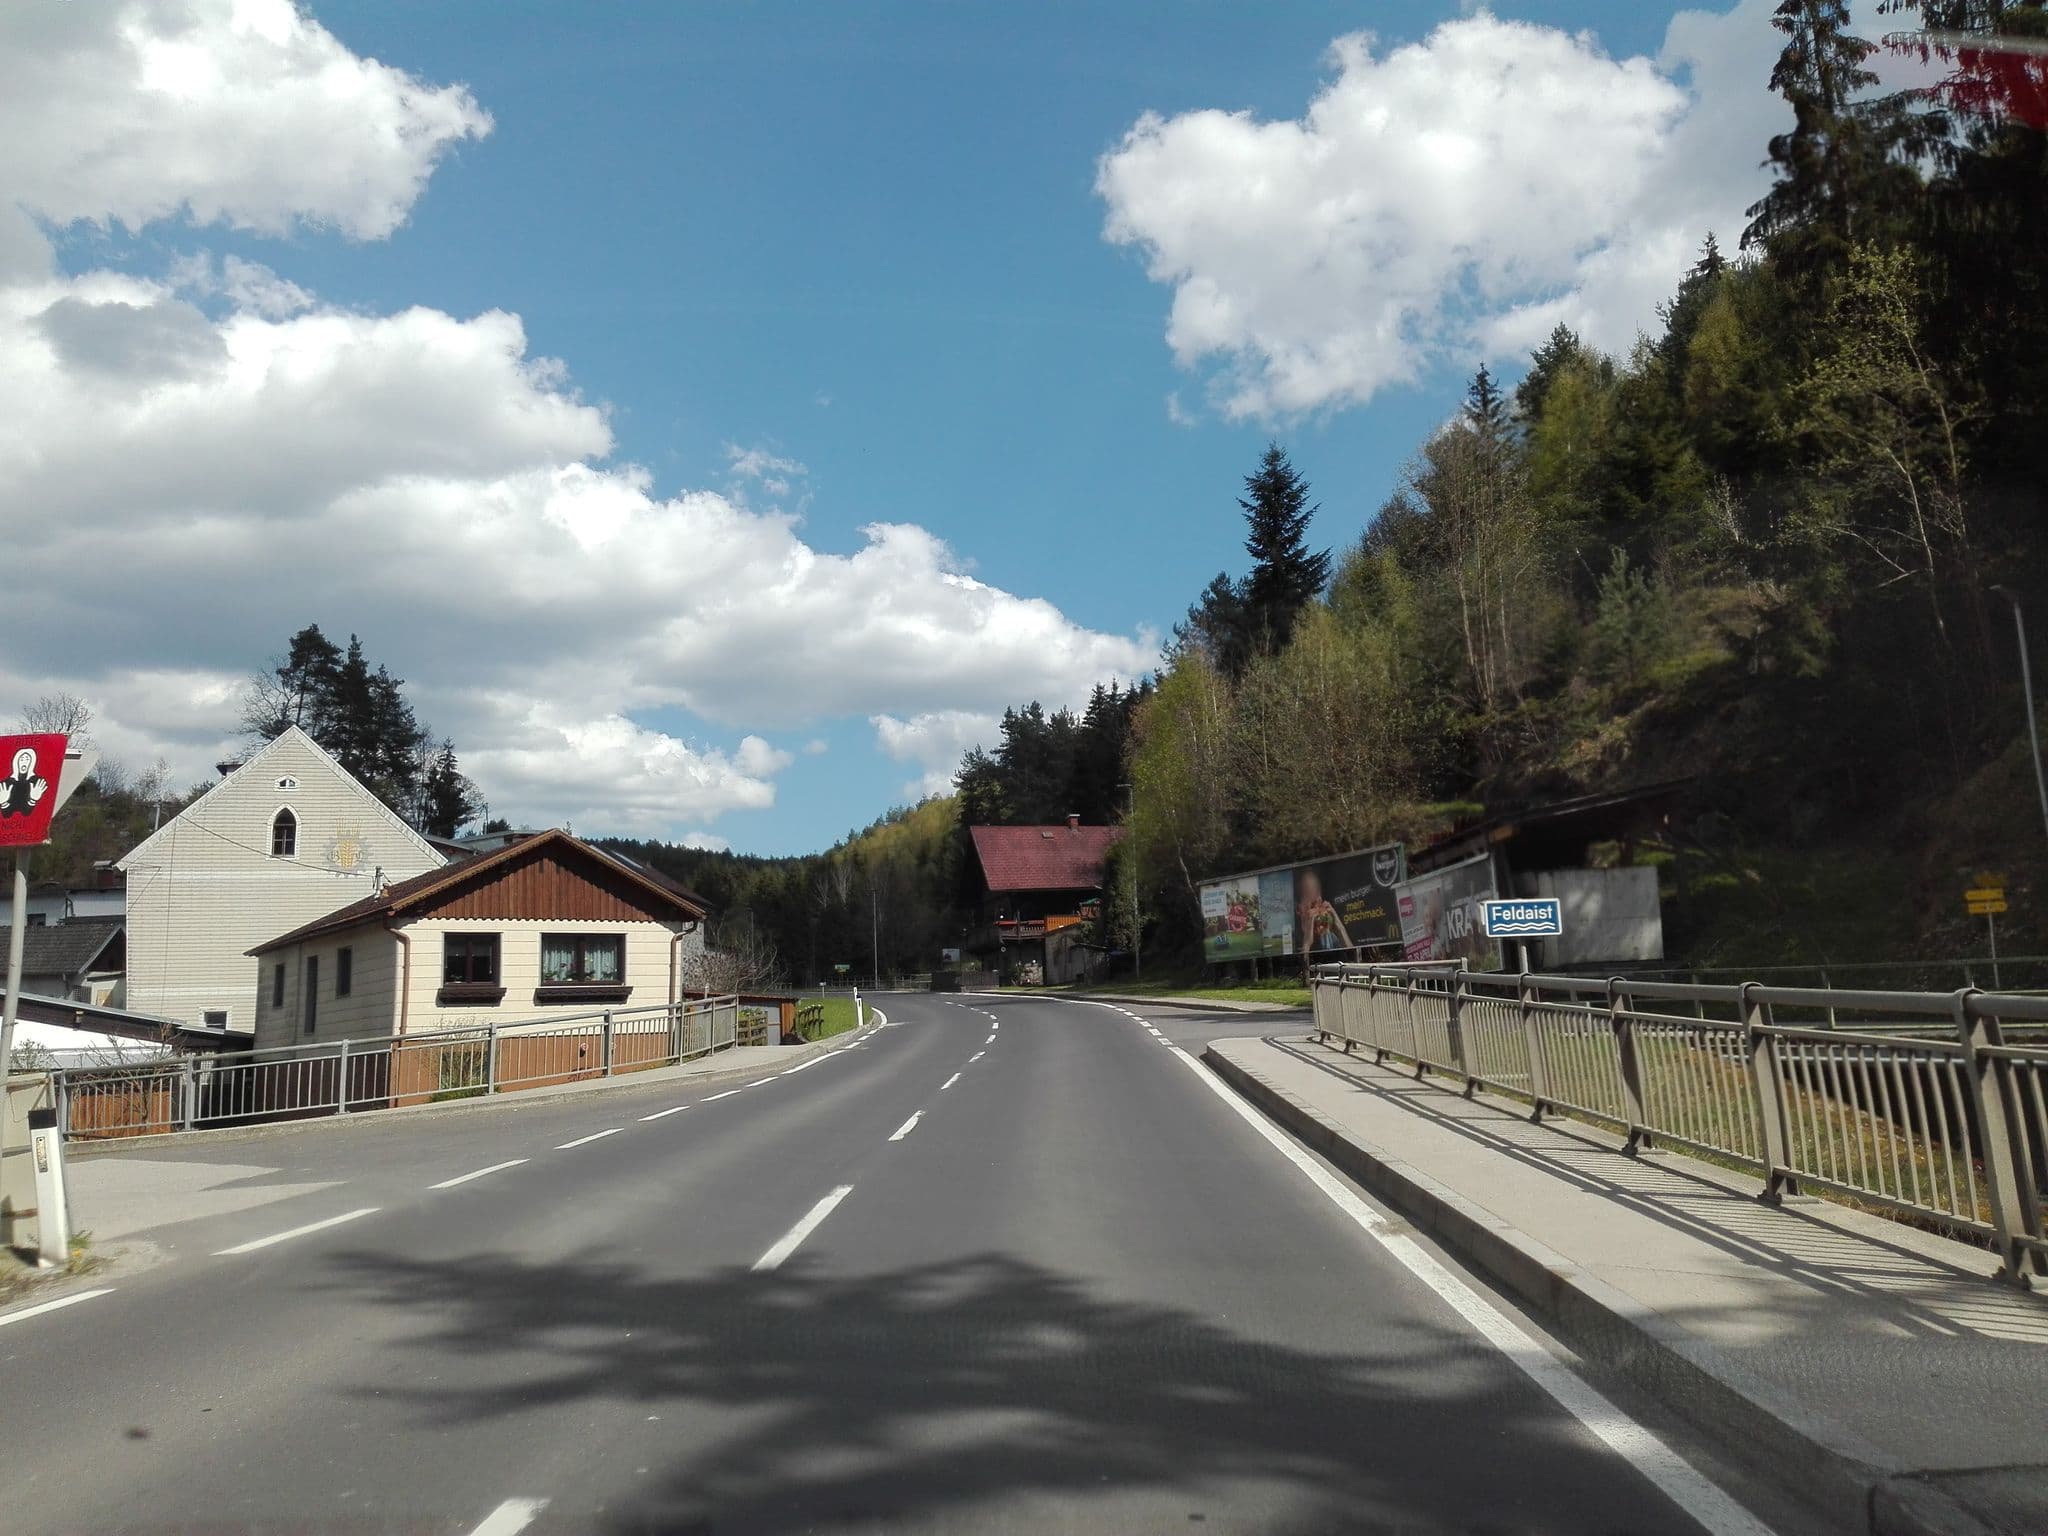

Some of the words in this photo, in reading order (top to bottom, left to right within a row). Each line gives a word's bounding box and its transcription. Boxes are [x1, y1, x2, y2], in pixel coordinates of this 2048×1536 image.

[1346, 899, 1365, 911] mein
[1492, 904, 1553, 921] Feldaist
[1447, 903, 1479, 940] KRA
